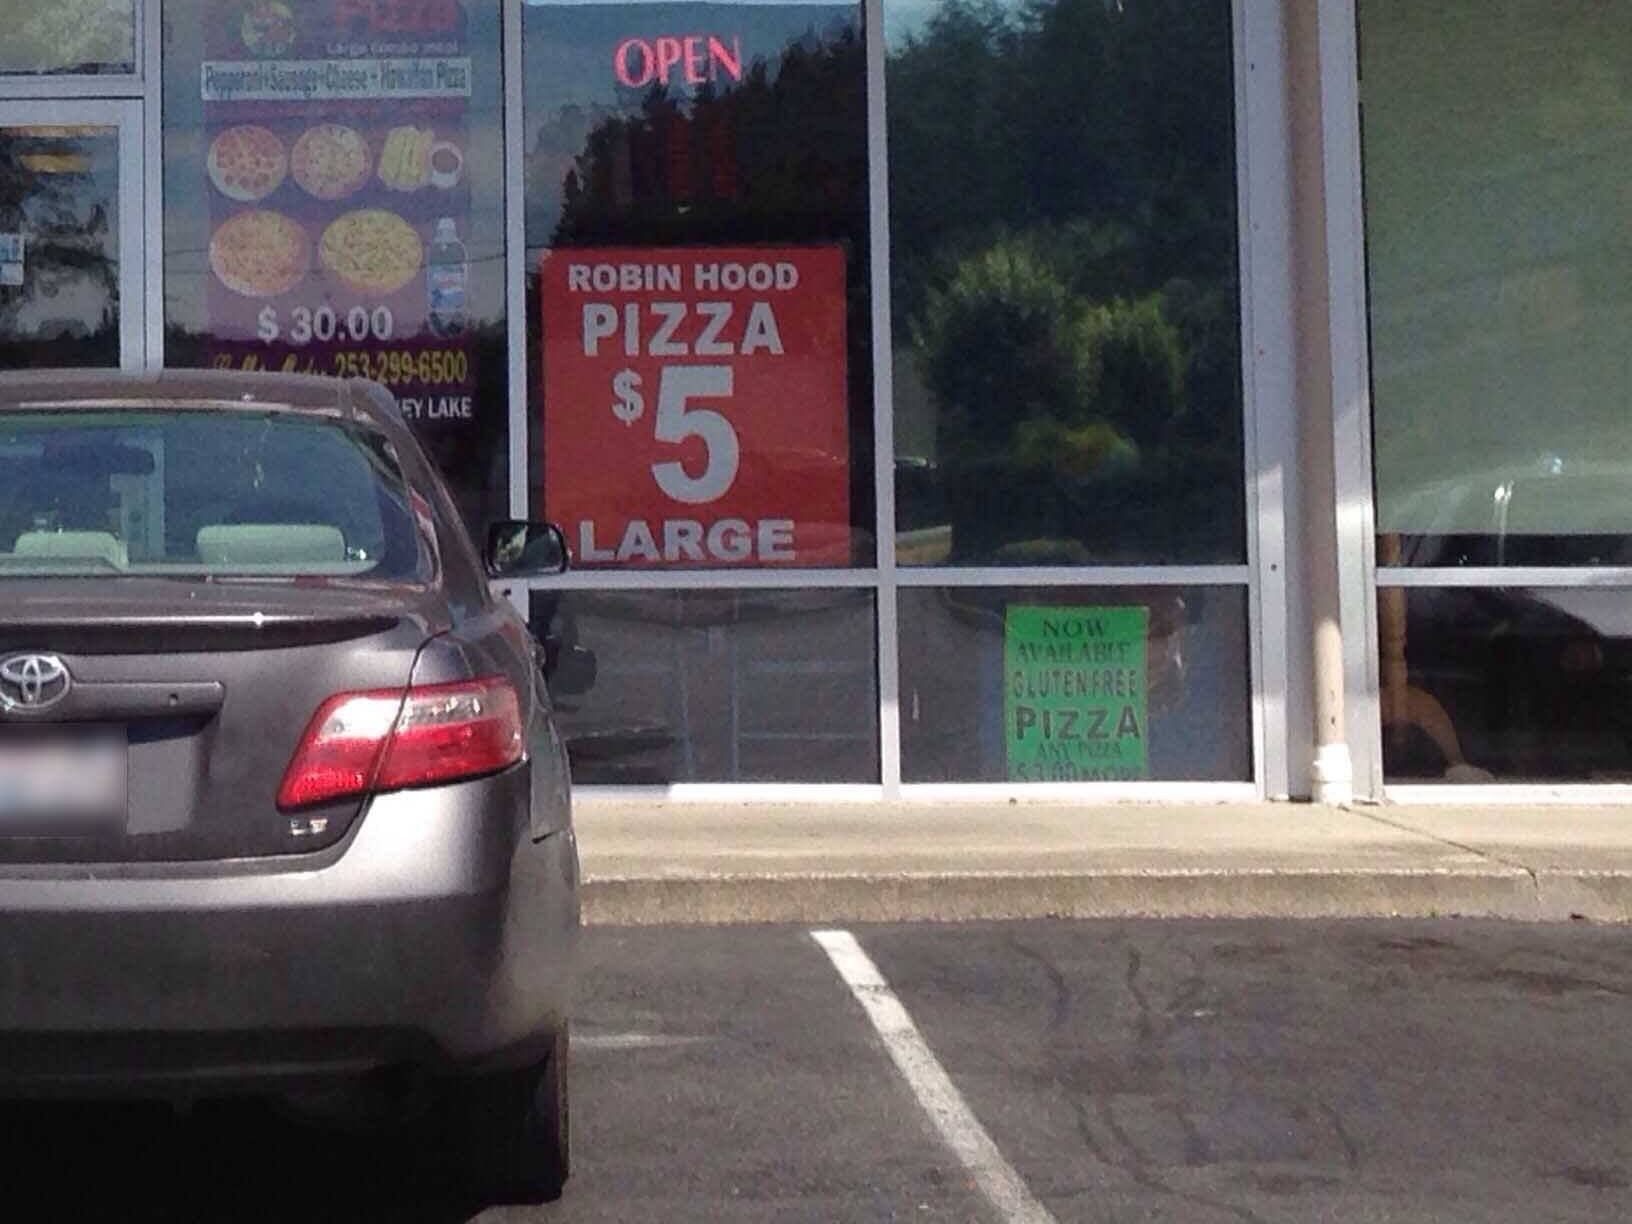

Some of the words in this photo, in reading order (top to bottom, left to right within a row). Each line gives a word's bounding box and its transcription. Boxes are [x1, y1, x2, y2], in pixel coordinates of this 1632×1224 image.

[614, 35, 742, 87] OPEN
[568, 263, 681, 292] ROBIN
[694, 262, 799, 291] HOOD
[583, 302, 784, 357] PIZZA
[335, 350, 468, 384] 253-299-6500
[428, 396, 472, 419] LAKE
[579, 519, 795, 561] LARGE
[1042, 618, 1106, 638] NOW
[1015, 706, 1141, 740] PIZZA
